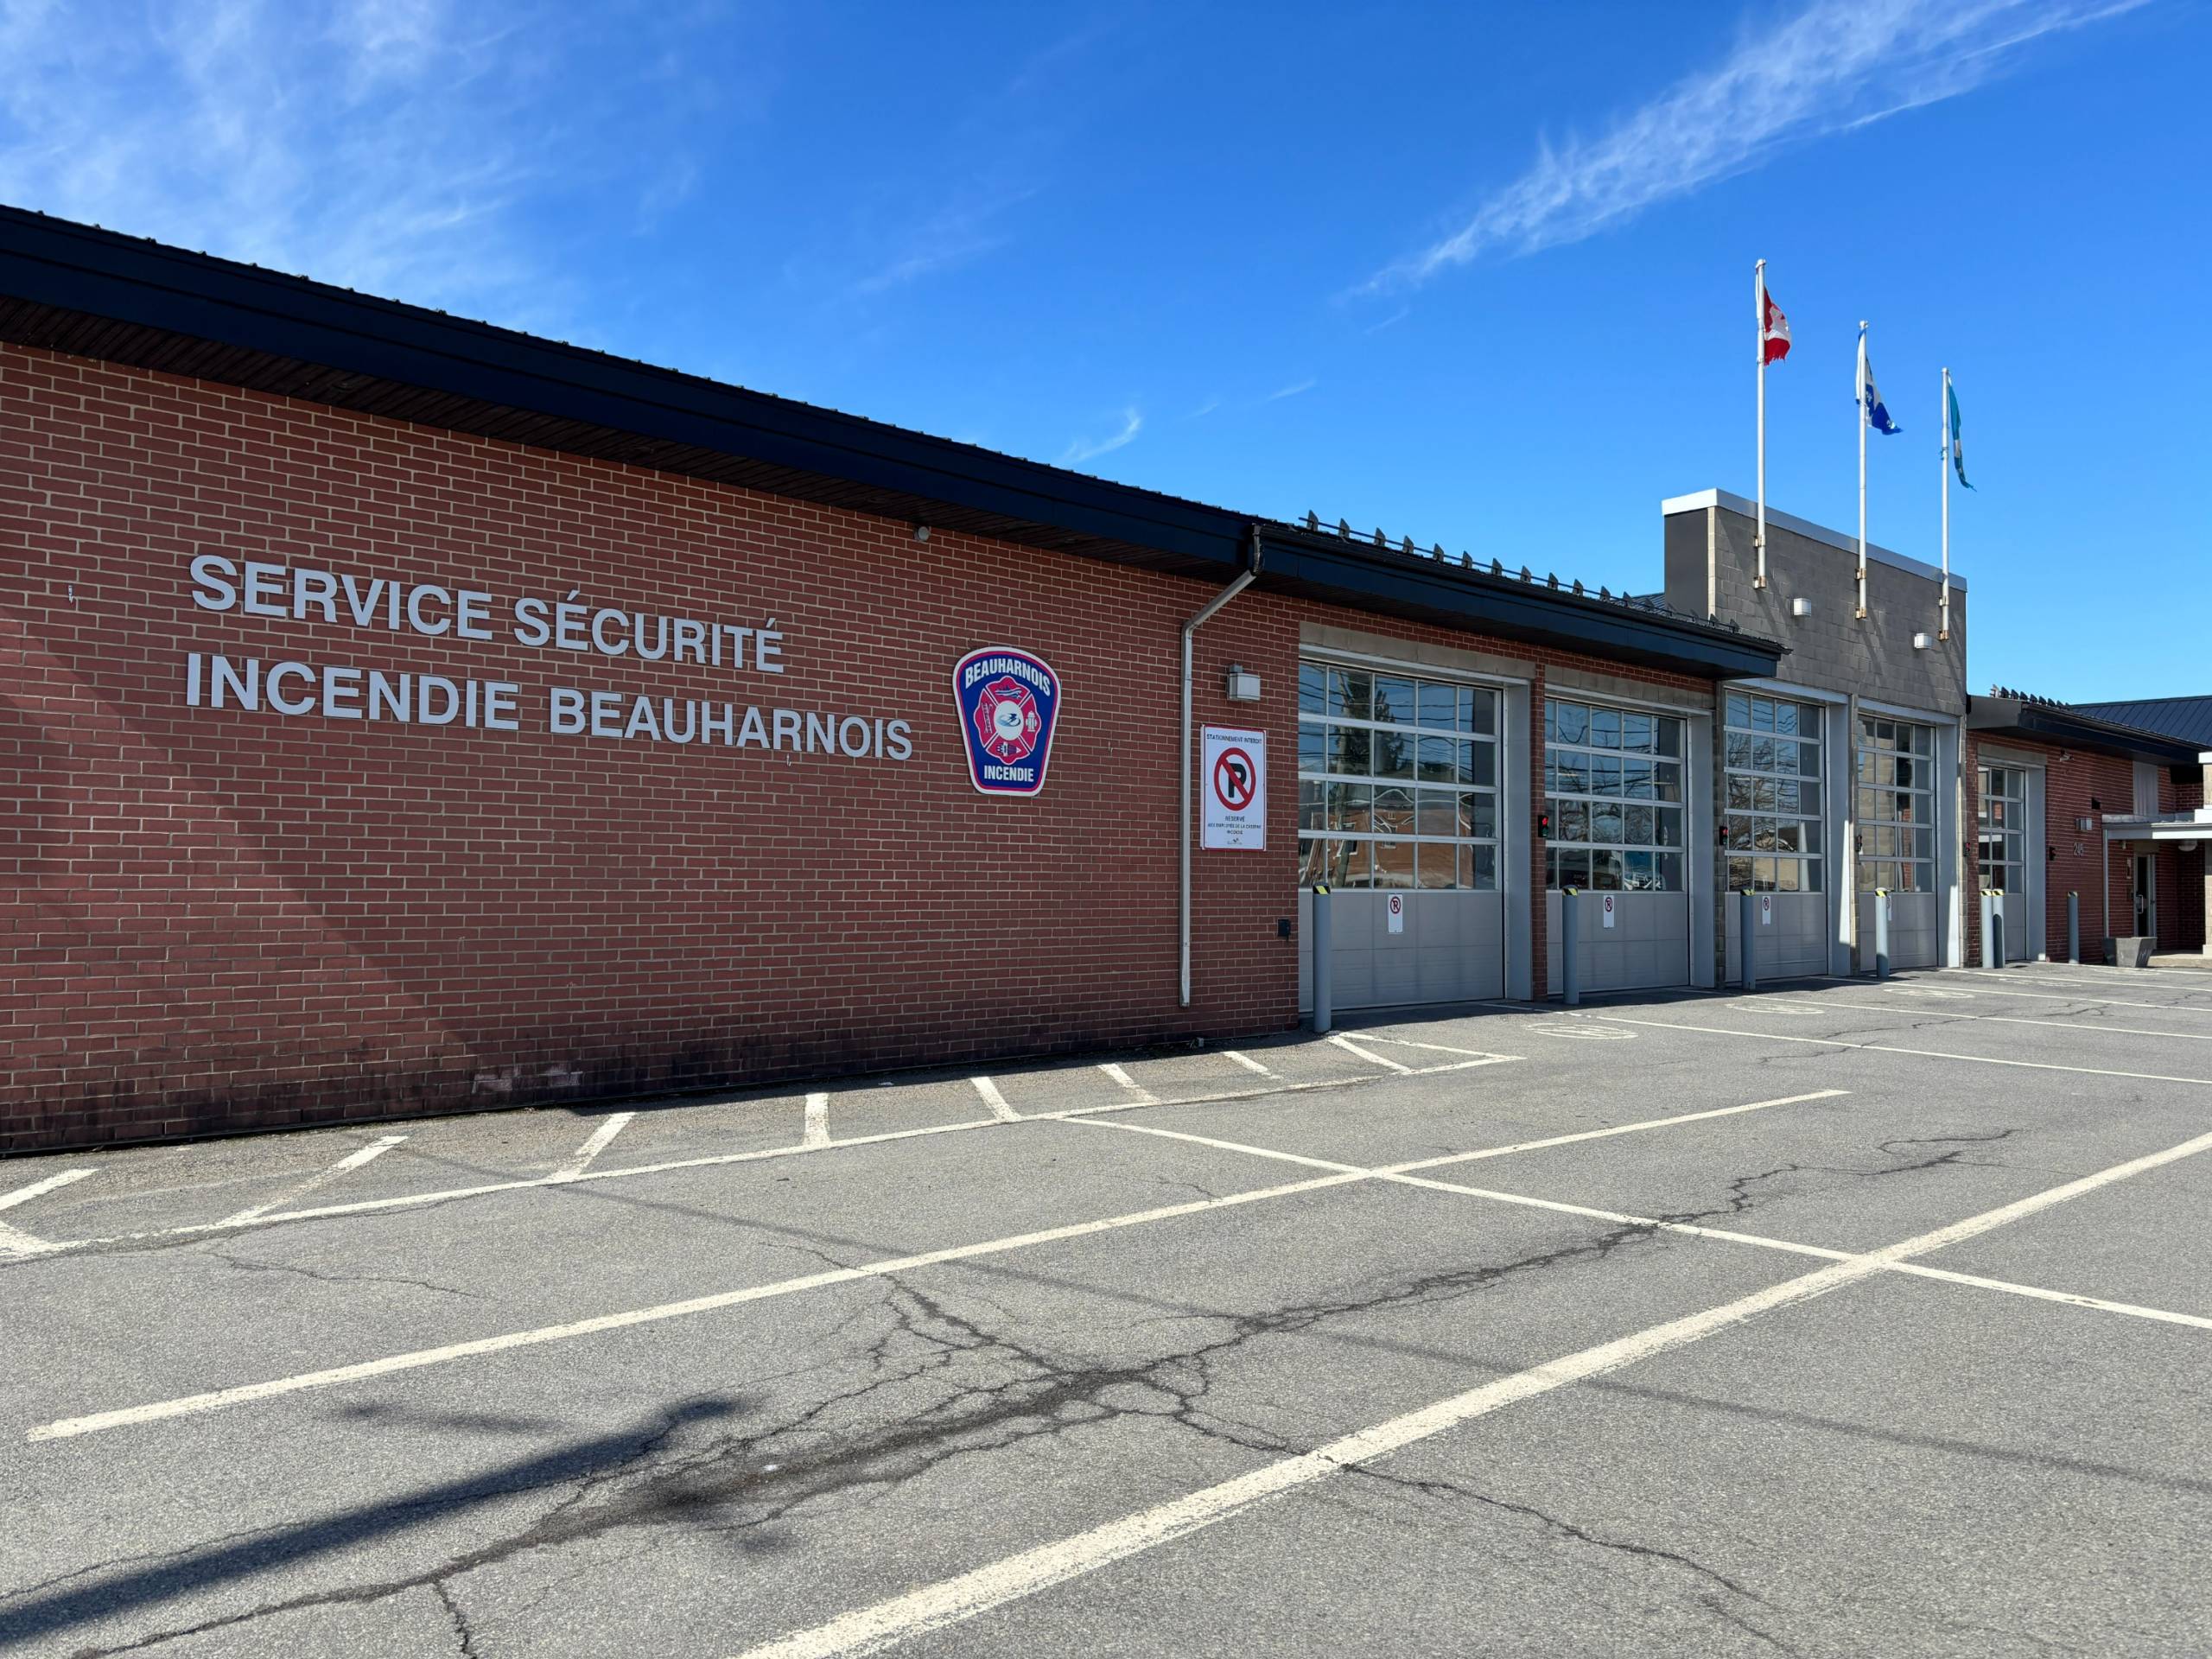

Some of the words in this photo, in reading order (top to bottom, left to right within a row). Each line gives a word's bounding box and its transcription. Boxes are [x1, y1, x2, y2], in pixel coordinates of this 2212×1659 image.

[189, 555, 493, 640] SERVICE
[514, 589, 785, 673] SÉCURITÉ
[186, 652, 519, 731] INCENDIE
[550, 687, 913, 760] BEAUHARNOIS
[965, 658, 1051, 696] BEAUHARNOIS
[983, 765, 1034, 782] INCENDIE
